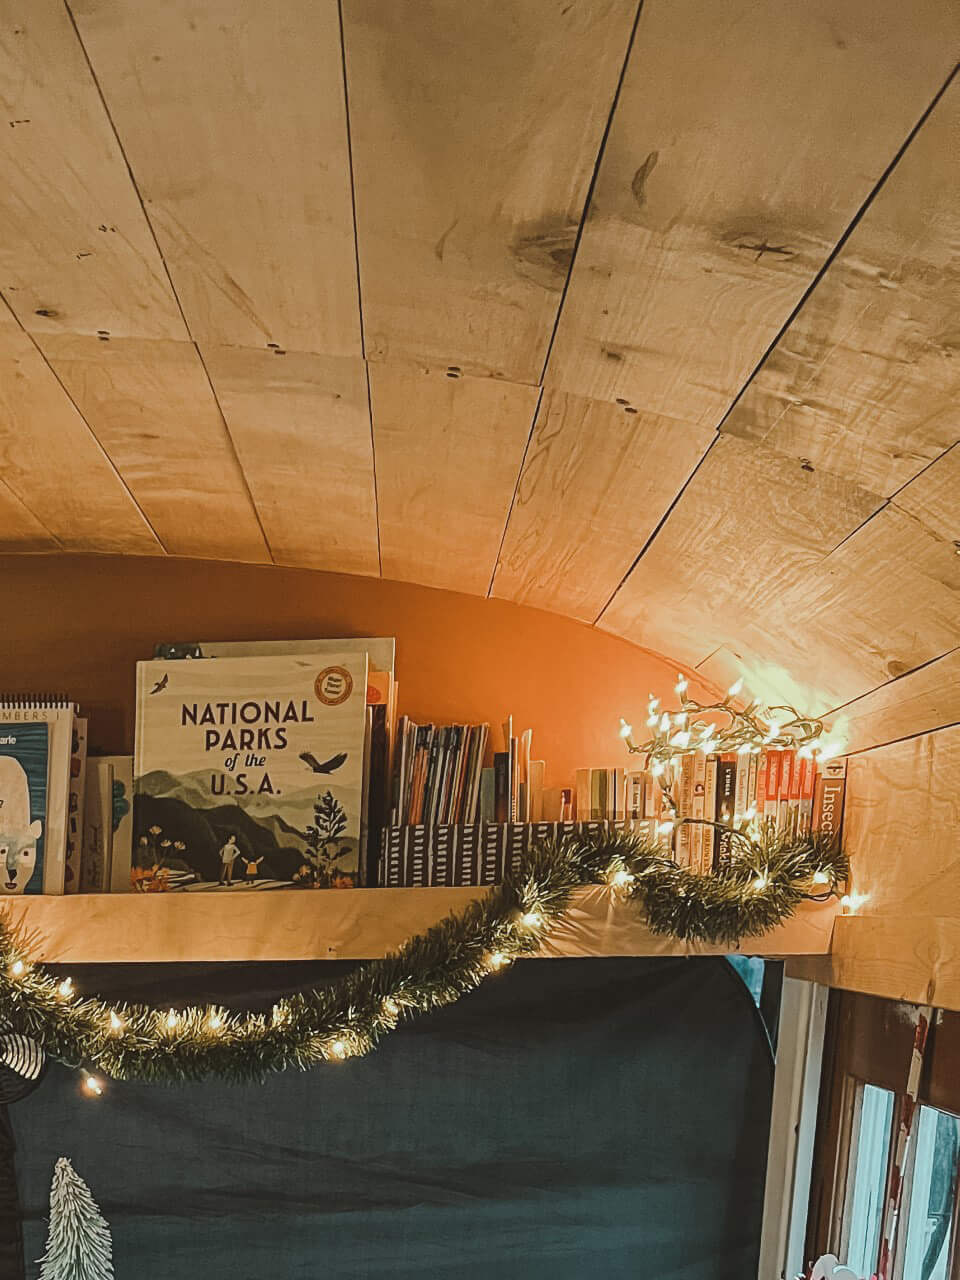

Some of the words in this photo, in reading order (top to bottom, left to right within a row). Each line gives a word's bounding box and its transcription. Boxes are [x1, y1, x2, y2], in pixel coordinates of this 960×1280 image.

[181, 700, 314, 726] NATIONAL
[205, 728, 288, 751] PARKS
[224, 753, 240, 771] of
[245, 753, 266, 767] the
[210, 773, 282, 796] U.S.A.
[719, 831, 731, 864] Wrinkl
